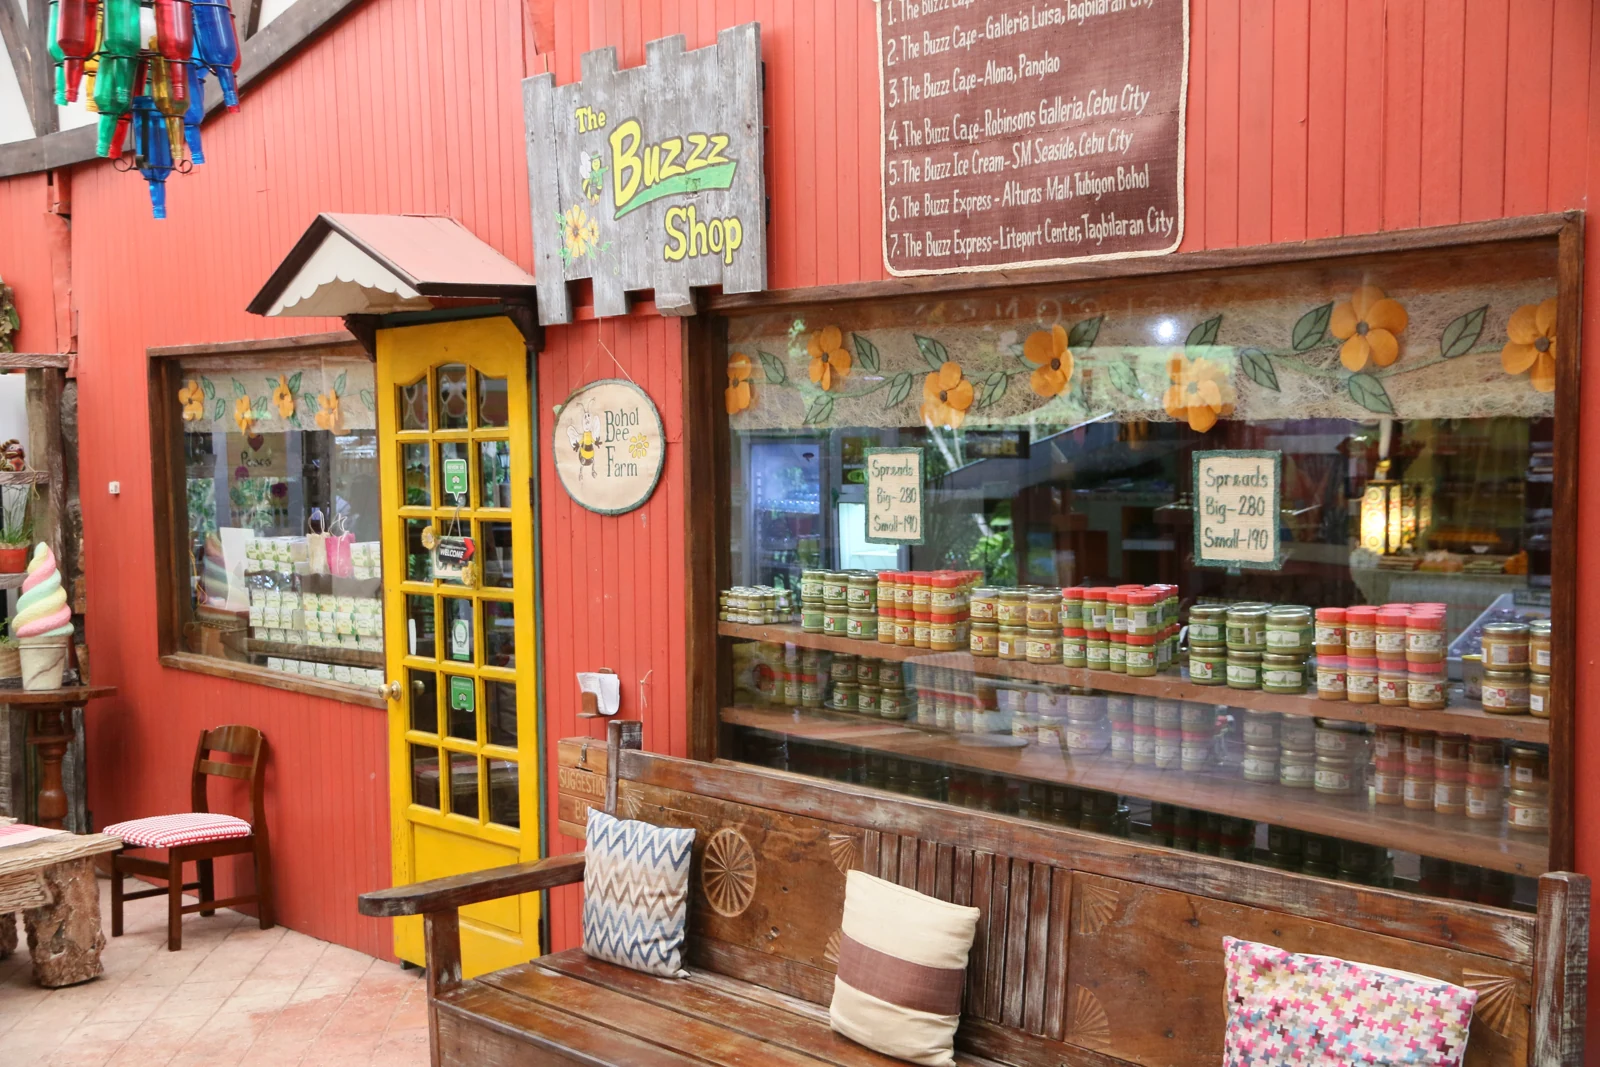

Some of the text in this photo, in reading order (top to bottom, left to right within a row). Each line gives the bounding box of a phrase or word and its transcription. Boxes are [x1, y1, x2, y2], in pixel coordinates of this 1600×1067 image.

[888, 0, 897, 26] 1.
[887, 39, 899, 66] 2.
[900, 35, 920, 61] The
[923, 31, 950, 56] Buzzz
[888, 78, 900, 108] 3.
[902, 76, 921, 103] The
[923, 72, 950, 99] Buzzz
[1018, 51, 1061, 82] Panglao
[575, 105, 607, 133] The
[888, 120, 902, 150] 4.
[903, 120, 922, 147] The
[924, 117, 950, 145] Buzzz
[1087, 88, 1118, 117] Cebu
[1120, 84, 1150, 116] City
[609, 117, 731, 208] Buzzz
[889, 161, 900, 186] 5.
[902, 159, 921, 183] The
[924, 157, 951, 182] Buzzz
[953, 152, 969, 176] Ice
[1012, 140, 1032, 169] SM
[1079, 131, 1105, 156] Cebu
[1108, 128, 1134, 155] City
[889, 197, 900, 222] 6.
[902, 196, 920, 219] The
[924, 193, 950, 216] Buzzz
[953, 189, 992, 219] Express
[1002, 180, 1042, 207] Alturas
[1047, 175, 1073, 201] Mall,
[1074, 170, 1115, 201] Tubigon
[1117, 163, 1149, 191] Bohol
[663, 204, 743, 266] Shop
[890, 234, 900, 258] 7.
[903, 233, 922, 258] The
[926, 231, 951, 257] Buzzz
[1081, 212, 1144, 246] Tagbilaran
[1147, 206, 1174, 238] City
[604, 407, 640, 428] Bohol
[605, 445, 638, 478] Farm
[1205, 464, 1268, 493] Spreads
[899, 487, 917, 504] 280
[439, 547, 464, 559] WELCOME
[559, 768, 606, 797] SUGGESTIO
[575, 800, 593, 820] BO
